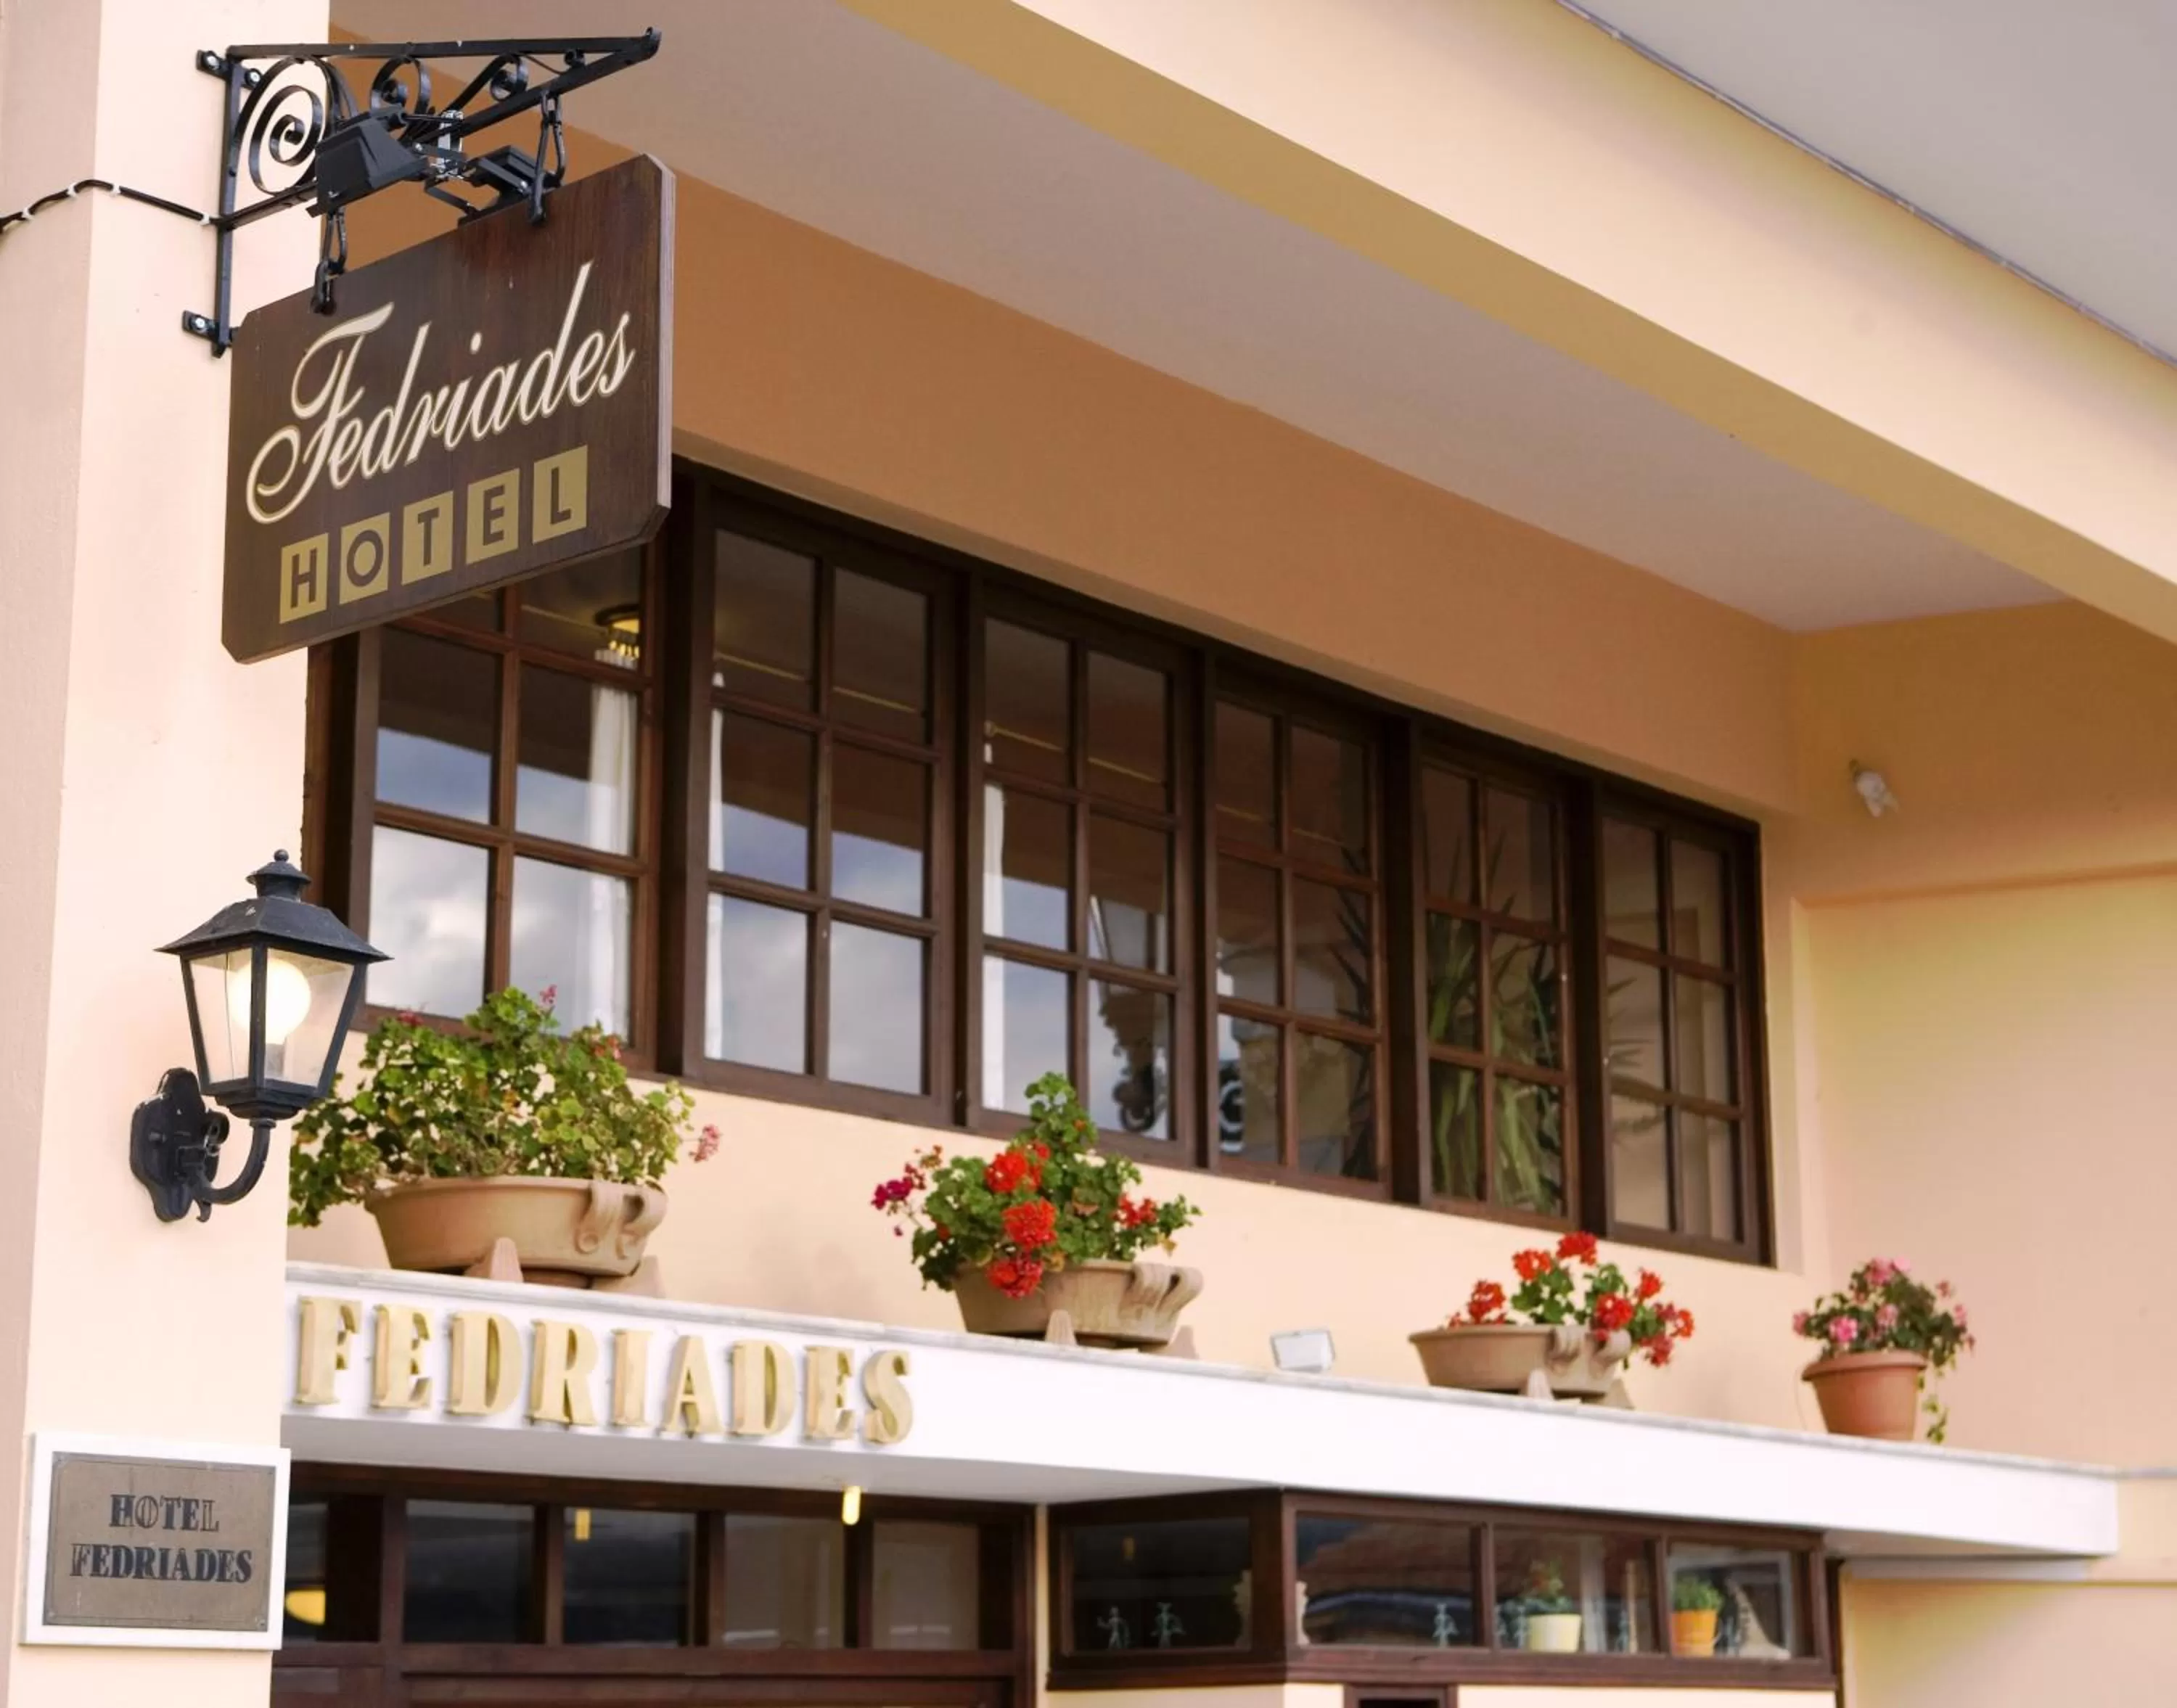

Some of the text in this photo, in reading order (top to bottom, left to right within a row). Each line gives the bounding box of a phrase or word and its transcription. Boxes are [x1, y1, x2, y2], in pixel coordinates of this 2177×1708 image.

[245, 259, 636, 524] Fedriades
[286, 459, 578, 616] HOTEL
[294, 1295, 915, 1445] FEDRIADES
[70, 1543, 253, 1583] FEDRIADES
[109, 1494, 220, 1533] HOTEL
